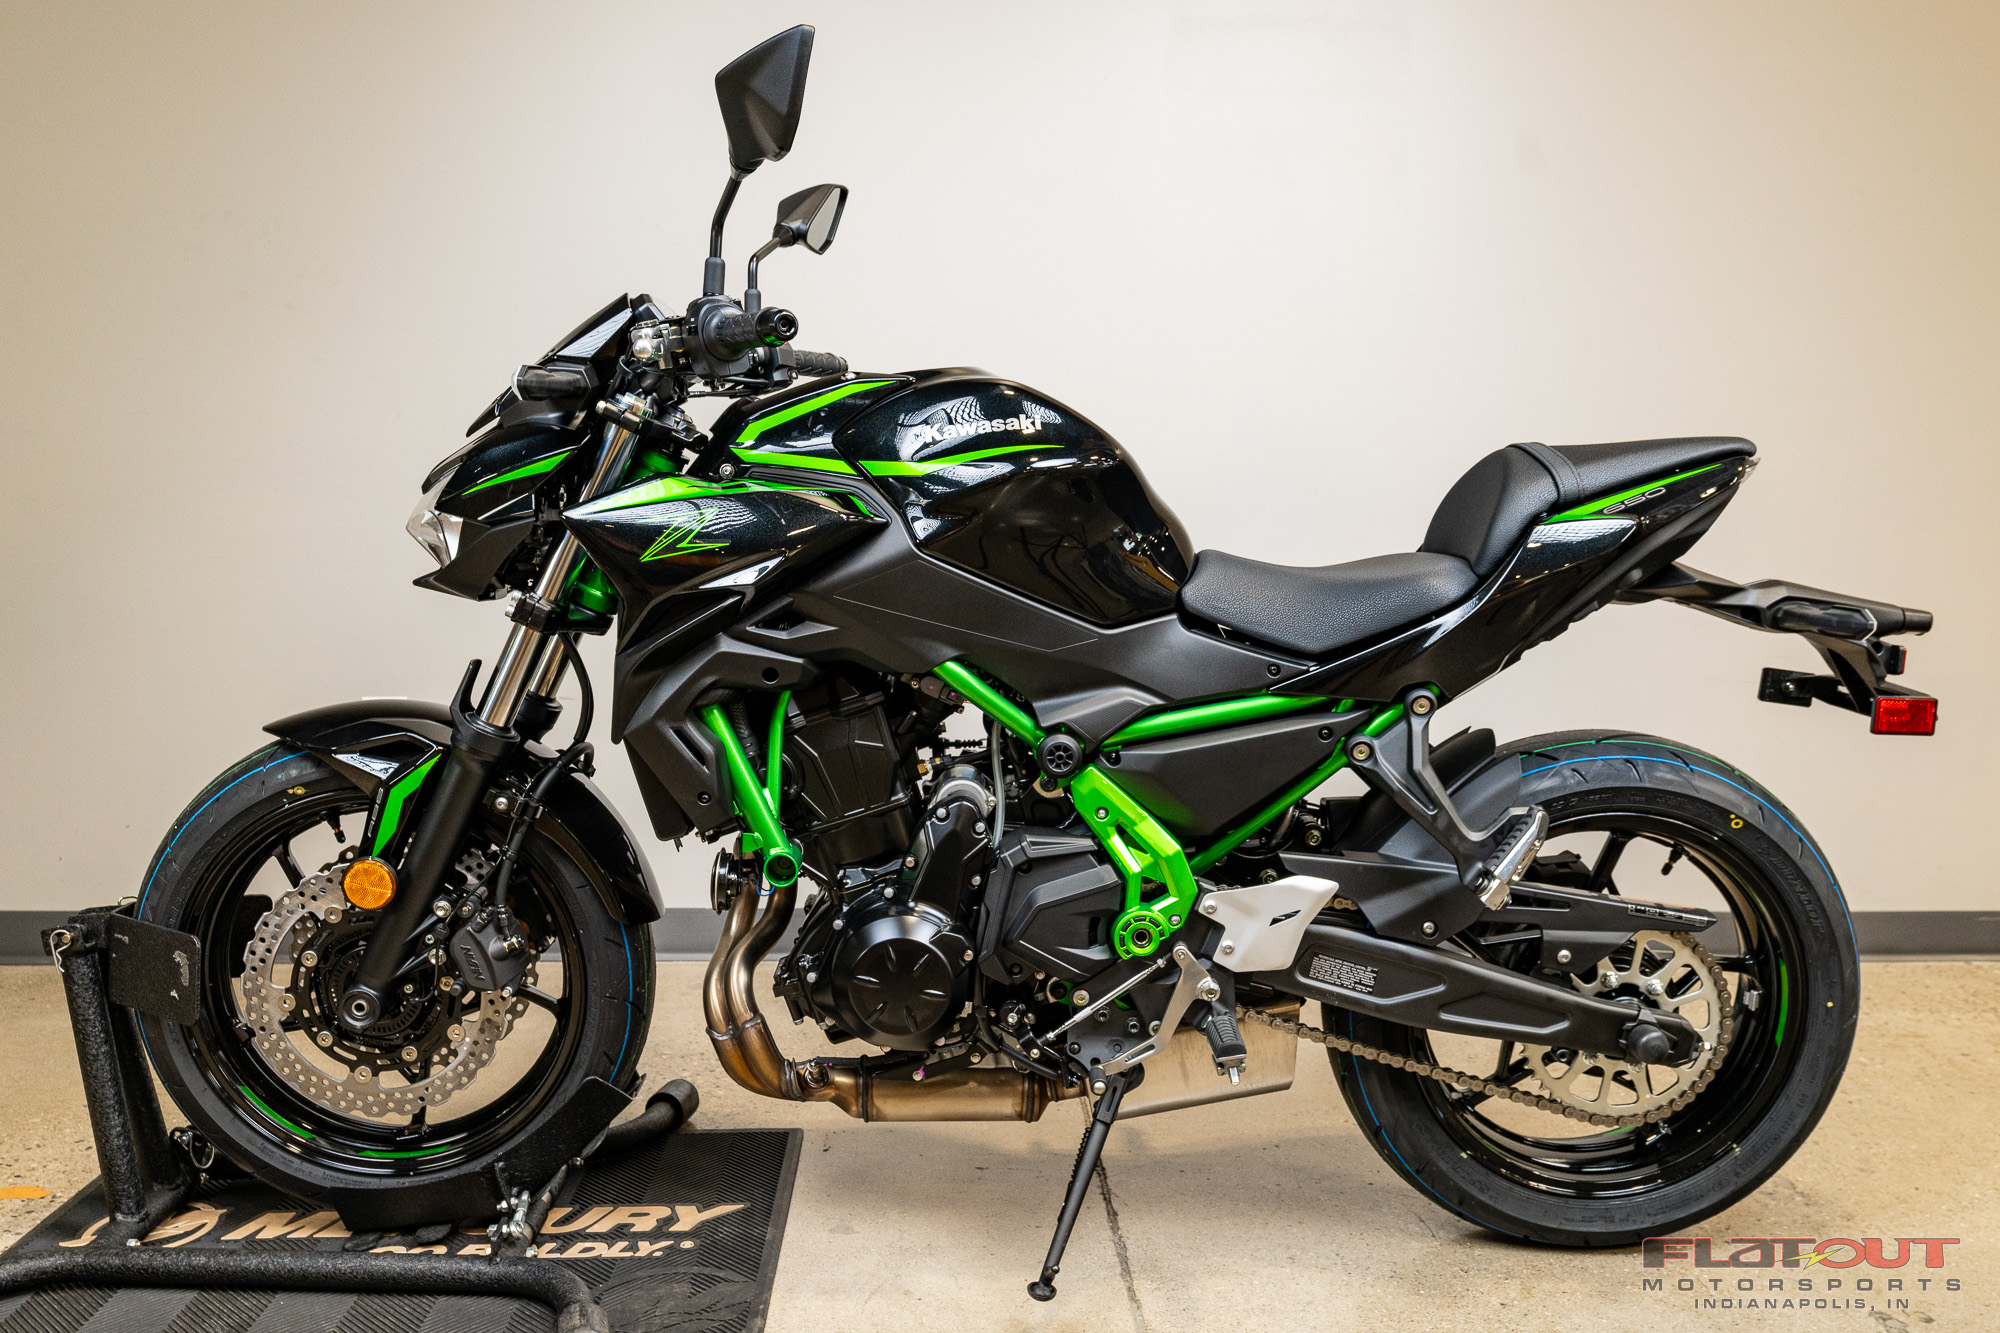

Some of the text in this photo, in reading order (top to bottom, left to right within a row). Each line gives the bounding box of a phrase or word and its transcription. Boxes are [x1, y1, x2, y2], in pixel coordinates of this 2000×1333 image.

[923, 414, 1043, 443] Kawasaki
[1603, 487, 1666, 515] 650
[367, 786, 384, 838] ABS
